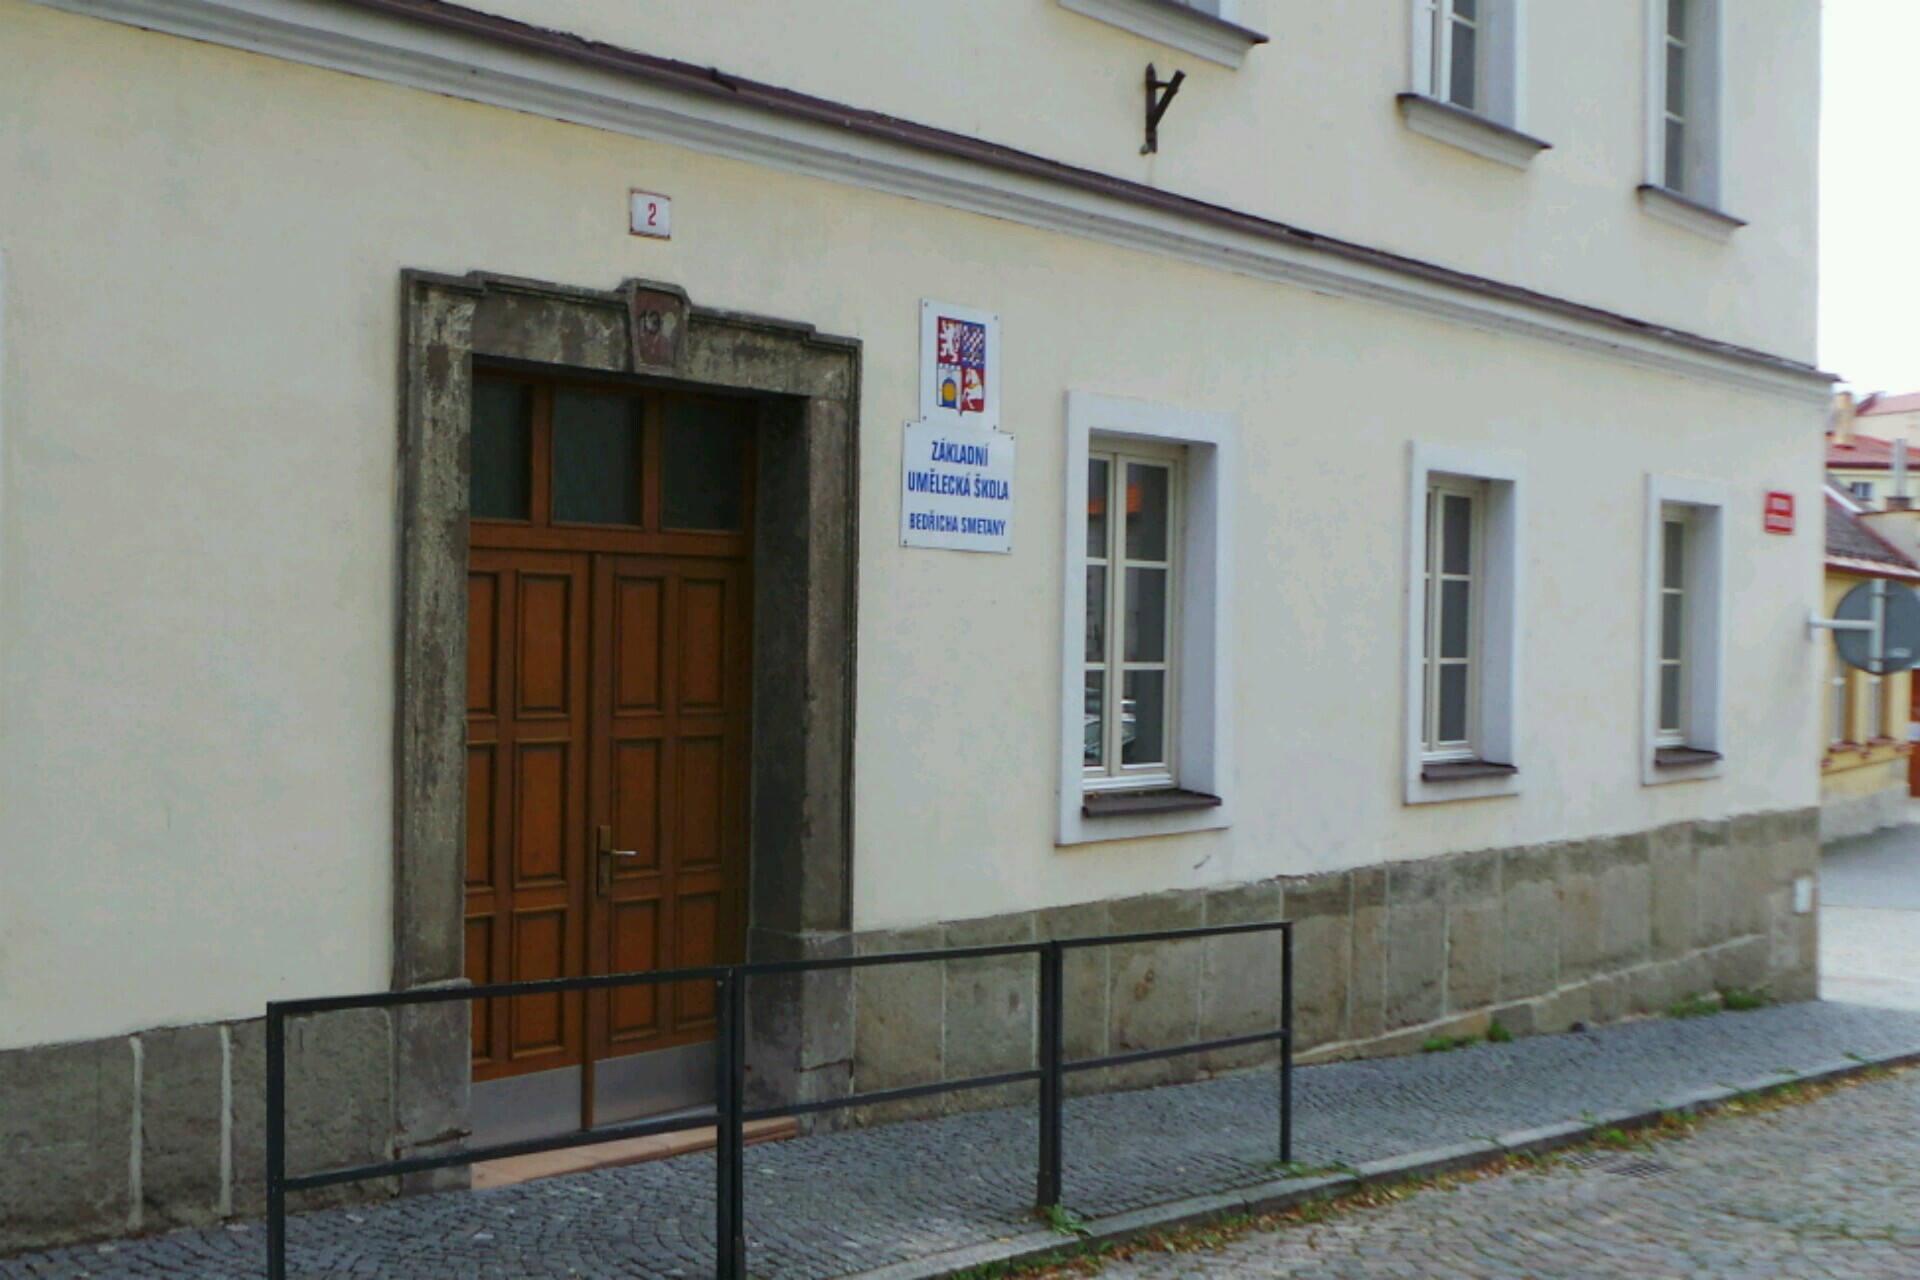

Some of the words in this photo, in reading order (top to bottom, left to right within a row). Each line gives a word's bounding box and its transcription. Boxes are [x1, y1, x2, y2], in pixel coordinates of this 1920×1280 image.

[648, 202, 657, 226] 2
[931, 438, 989, 466] ZÁKLADNÍ
[908, 468, 970, 496] UMĚLECKÁ
[974, 473, 1009, 500] ŠKOLA
[909, 509, 958, 532] BEDŘICHA
[961, 516, 1006, 536] SMETANY
